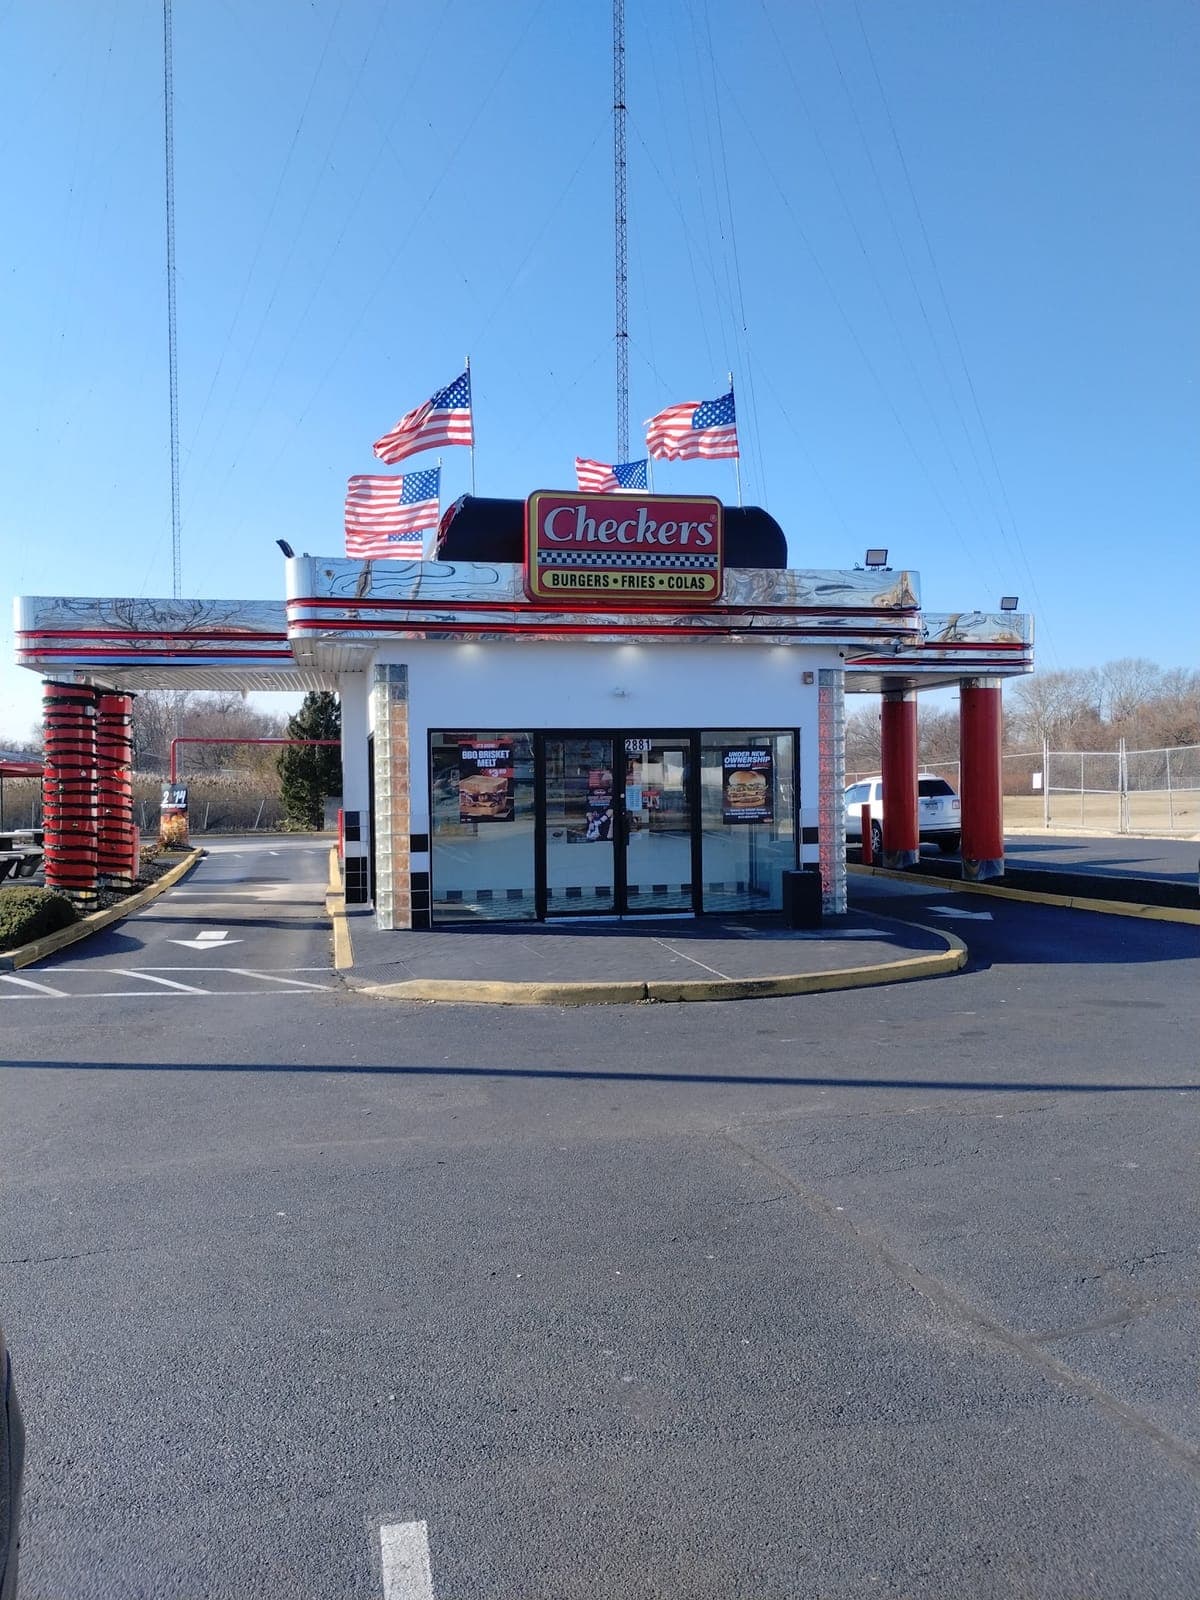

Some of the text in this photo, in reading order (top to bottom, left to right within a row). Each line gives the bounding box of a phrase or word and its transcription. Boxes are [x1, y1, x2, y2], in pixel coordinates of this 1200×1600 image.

[544, 505, 713, 546] Checkers
[552, 573, 705, 590] BURGERS FRIES COLAS
[625, 739, 650, 751] 2881
[462, 749, 510, 760] BBQ BRISKET
[724, 756, 771, 764] OWNERSHIP
[477, 759, 496, 767] MELT
